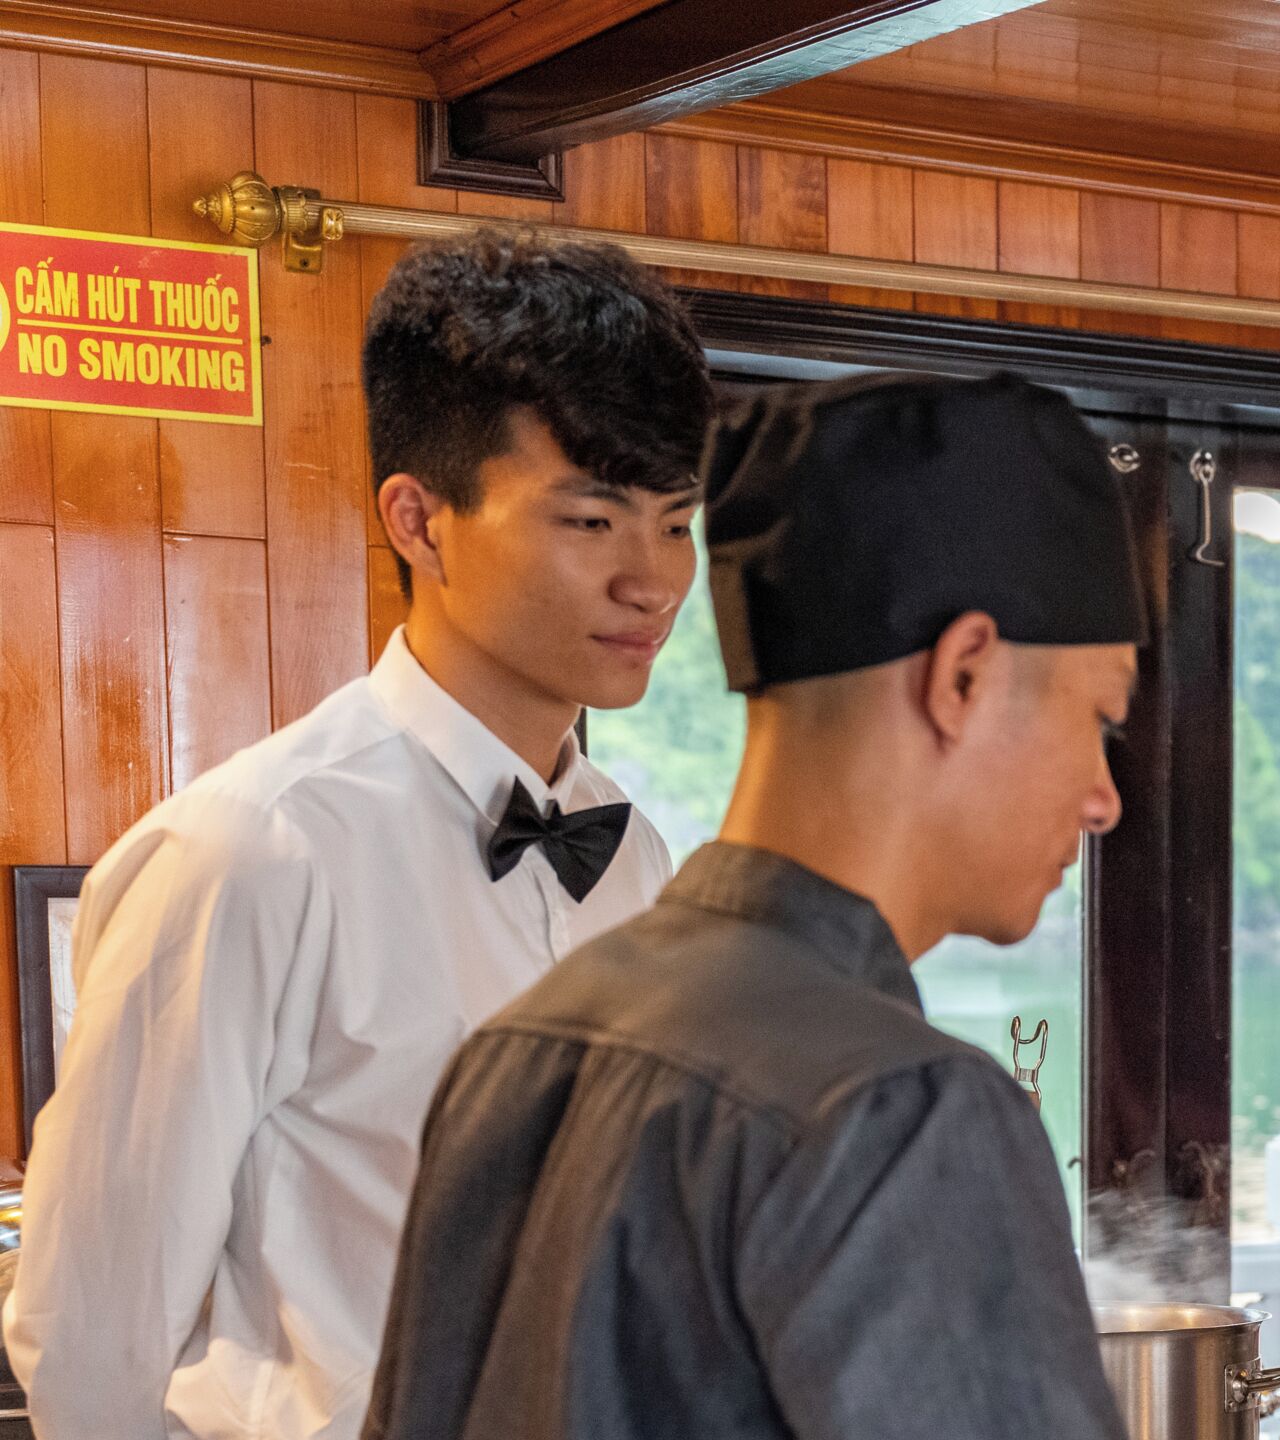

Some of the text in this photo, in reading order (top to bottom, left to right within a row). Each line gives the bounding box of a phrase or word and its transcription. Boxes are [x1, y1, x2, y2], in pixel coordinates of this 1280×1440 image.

[15, 257, 240, 333] CẤM HÚT THUỐC
[18, 333, 245, 392] NO SMOKING
